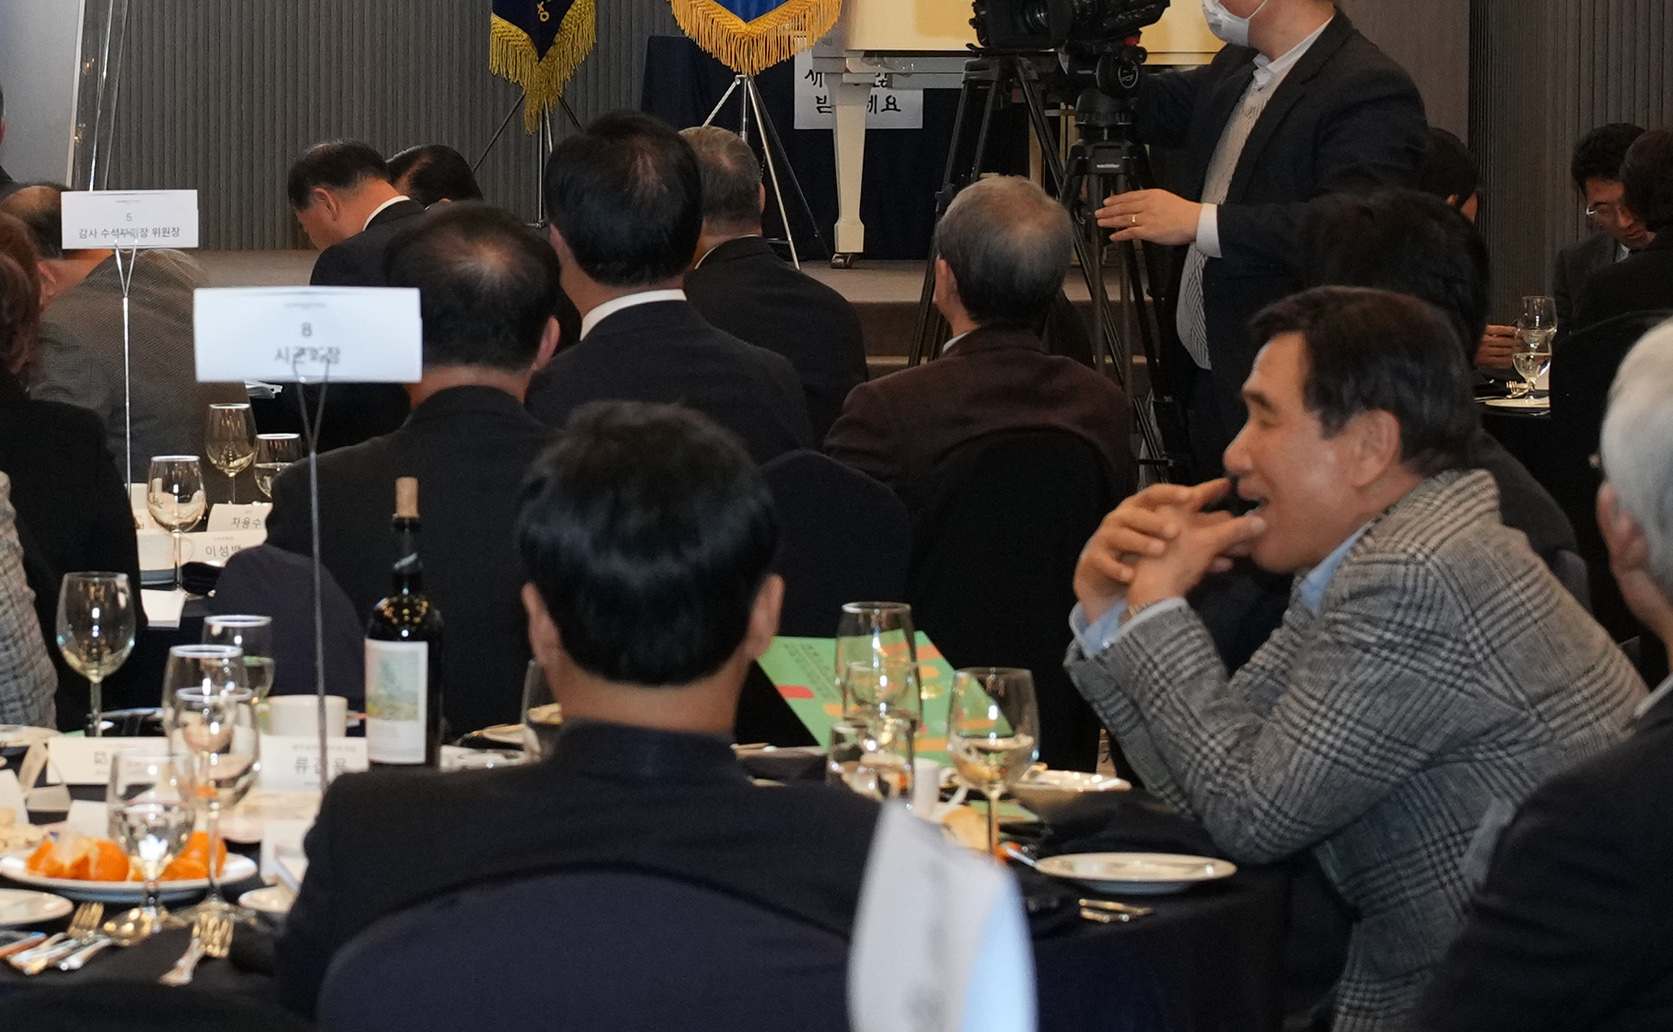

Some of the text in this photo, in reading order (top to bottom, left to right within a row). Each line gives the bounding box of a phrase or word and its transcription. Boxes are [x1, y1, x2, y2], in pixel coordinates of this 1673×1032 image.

[125, 212, 134, 222] 5
[151, 226, 181, 238] 위원장
[300, 322, 313, 337] 8
